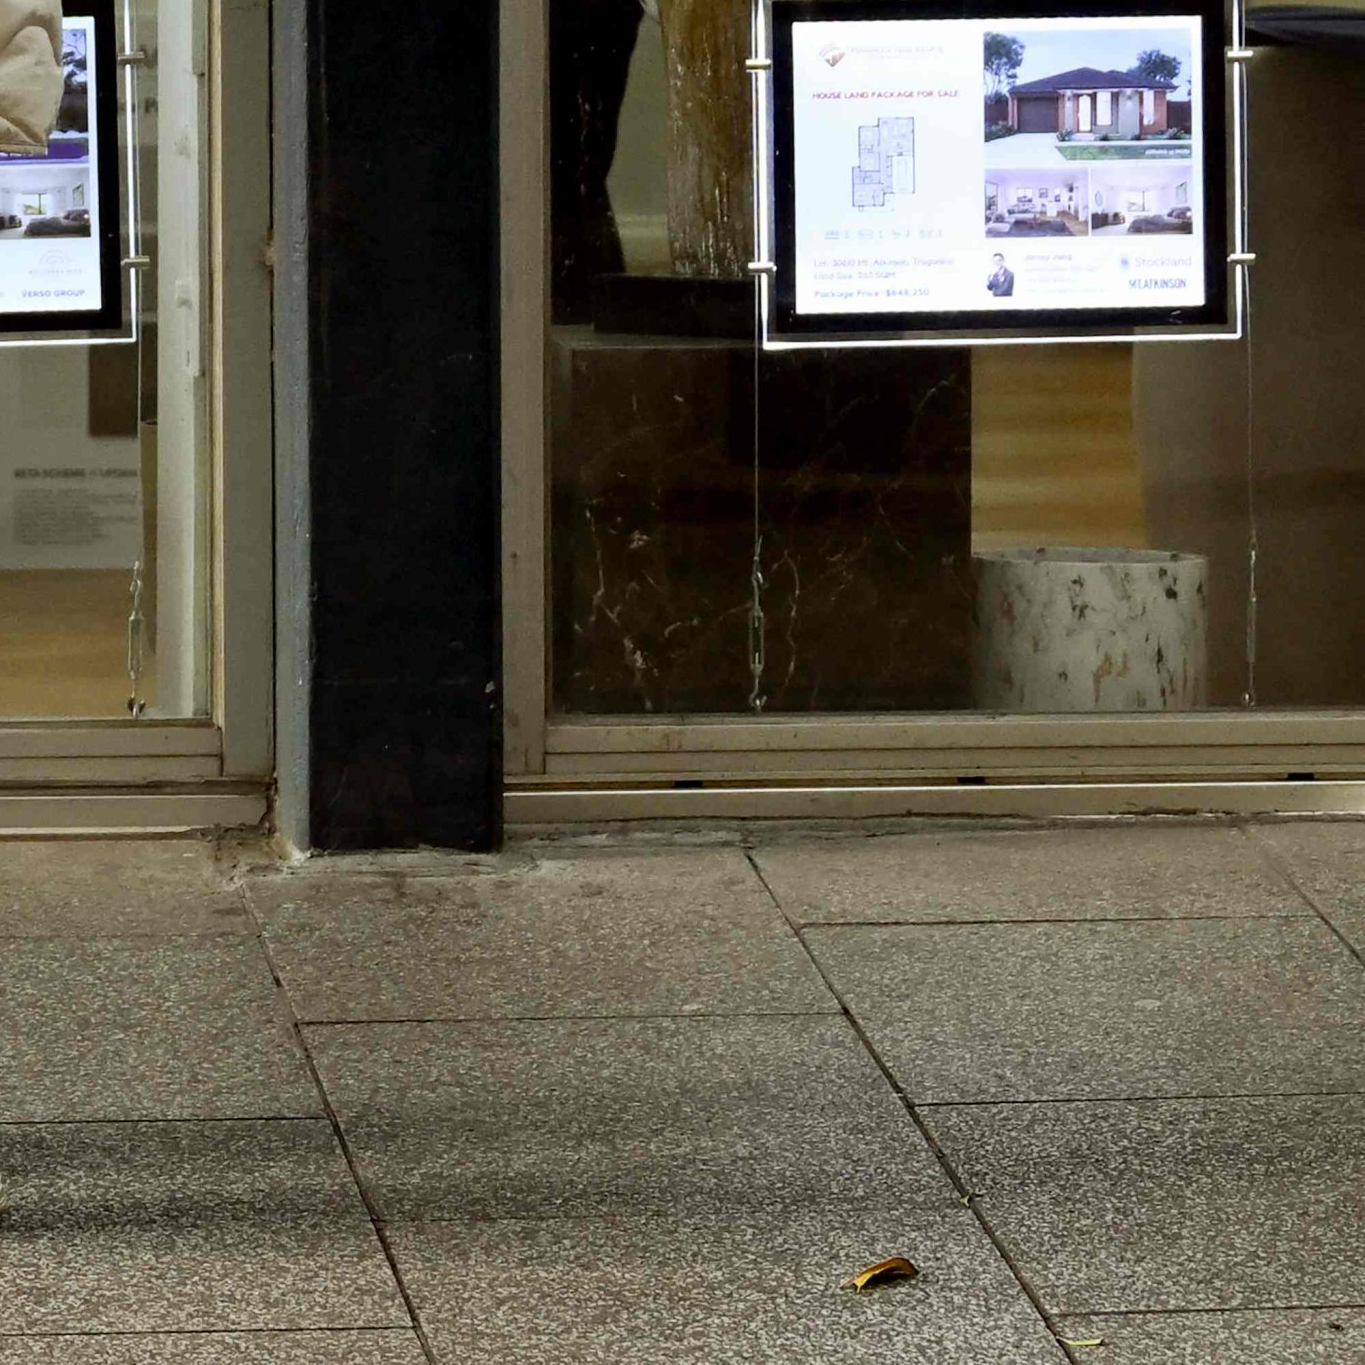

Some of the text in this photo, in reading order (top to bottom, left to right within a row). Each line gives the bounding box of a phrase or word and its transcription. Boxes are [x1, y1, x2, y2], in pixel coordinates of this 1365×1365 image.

[812, 92, 841, 100] HOUSE
[938, 90, 958, 98] SALE
[1135, 257, 1192, 267] Stockland
[22, 289, 85, 298] VERSO GROUP
